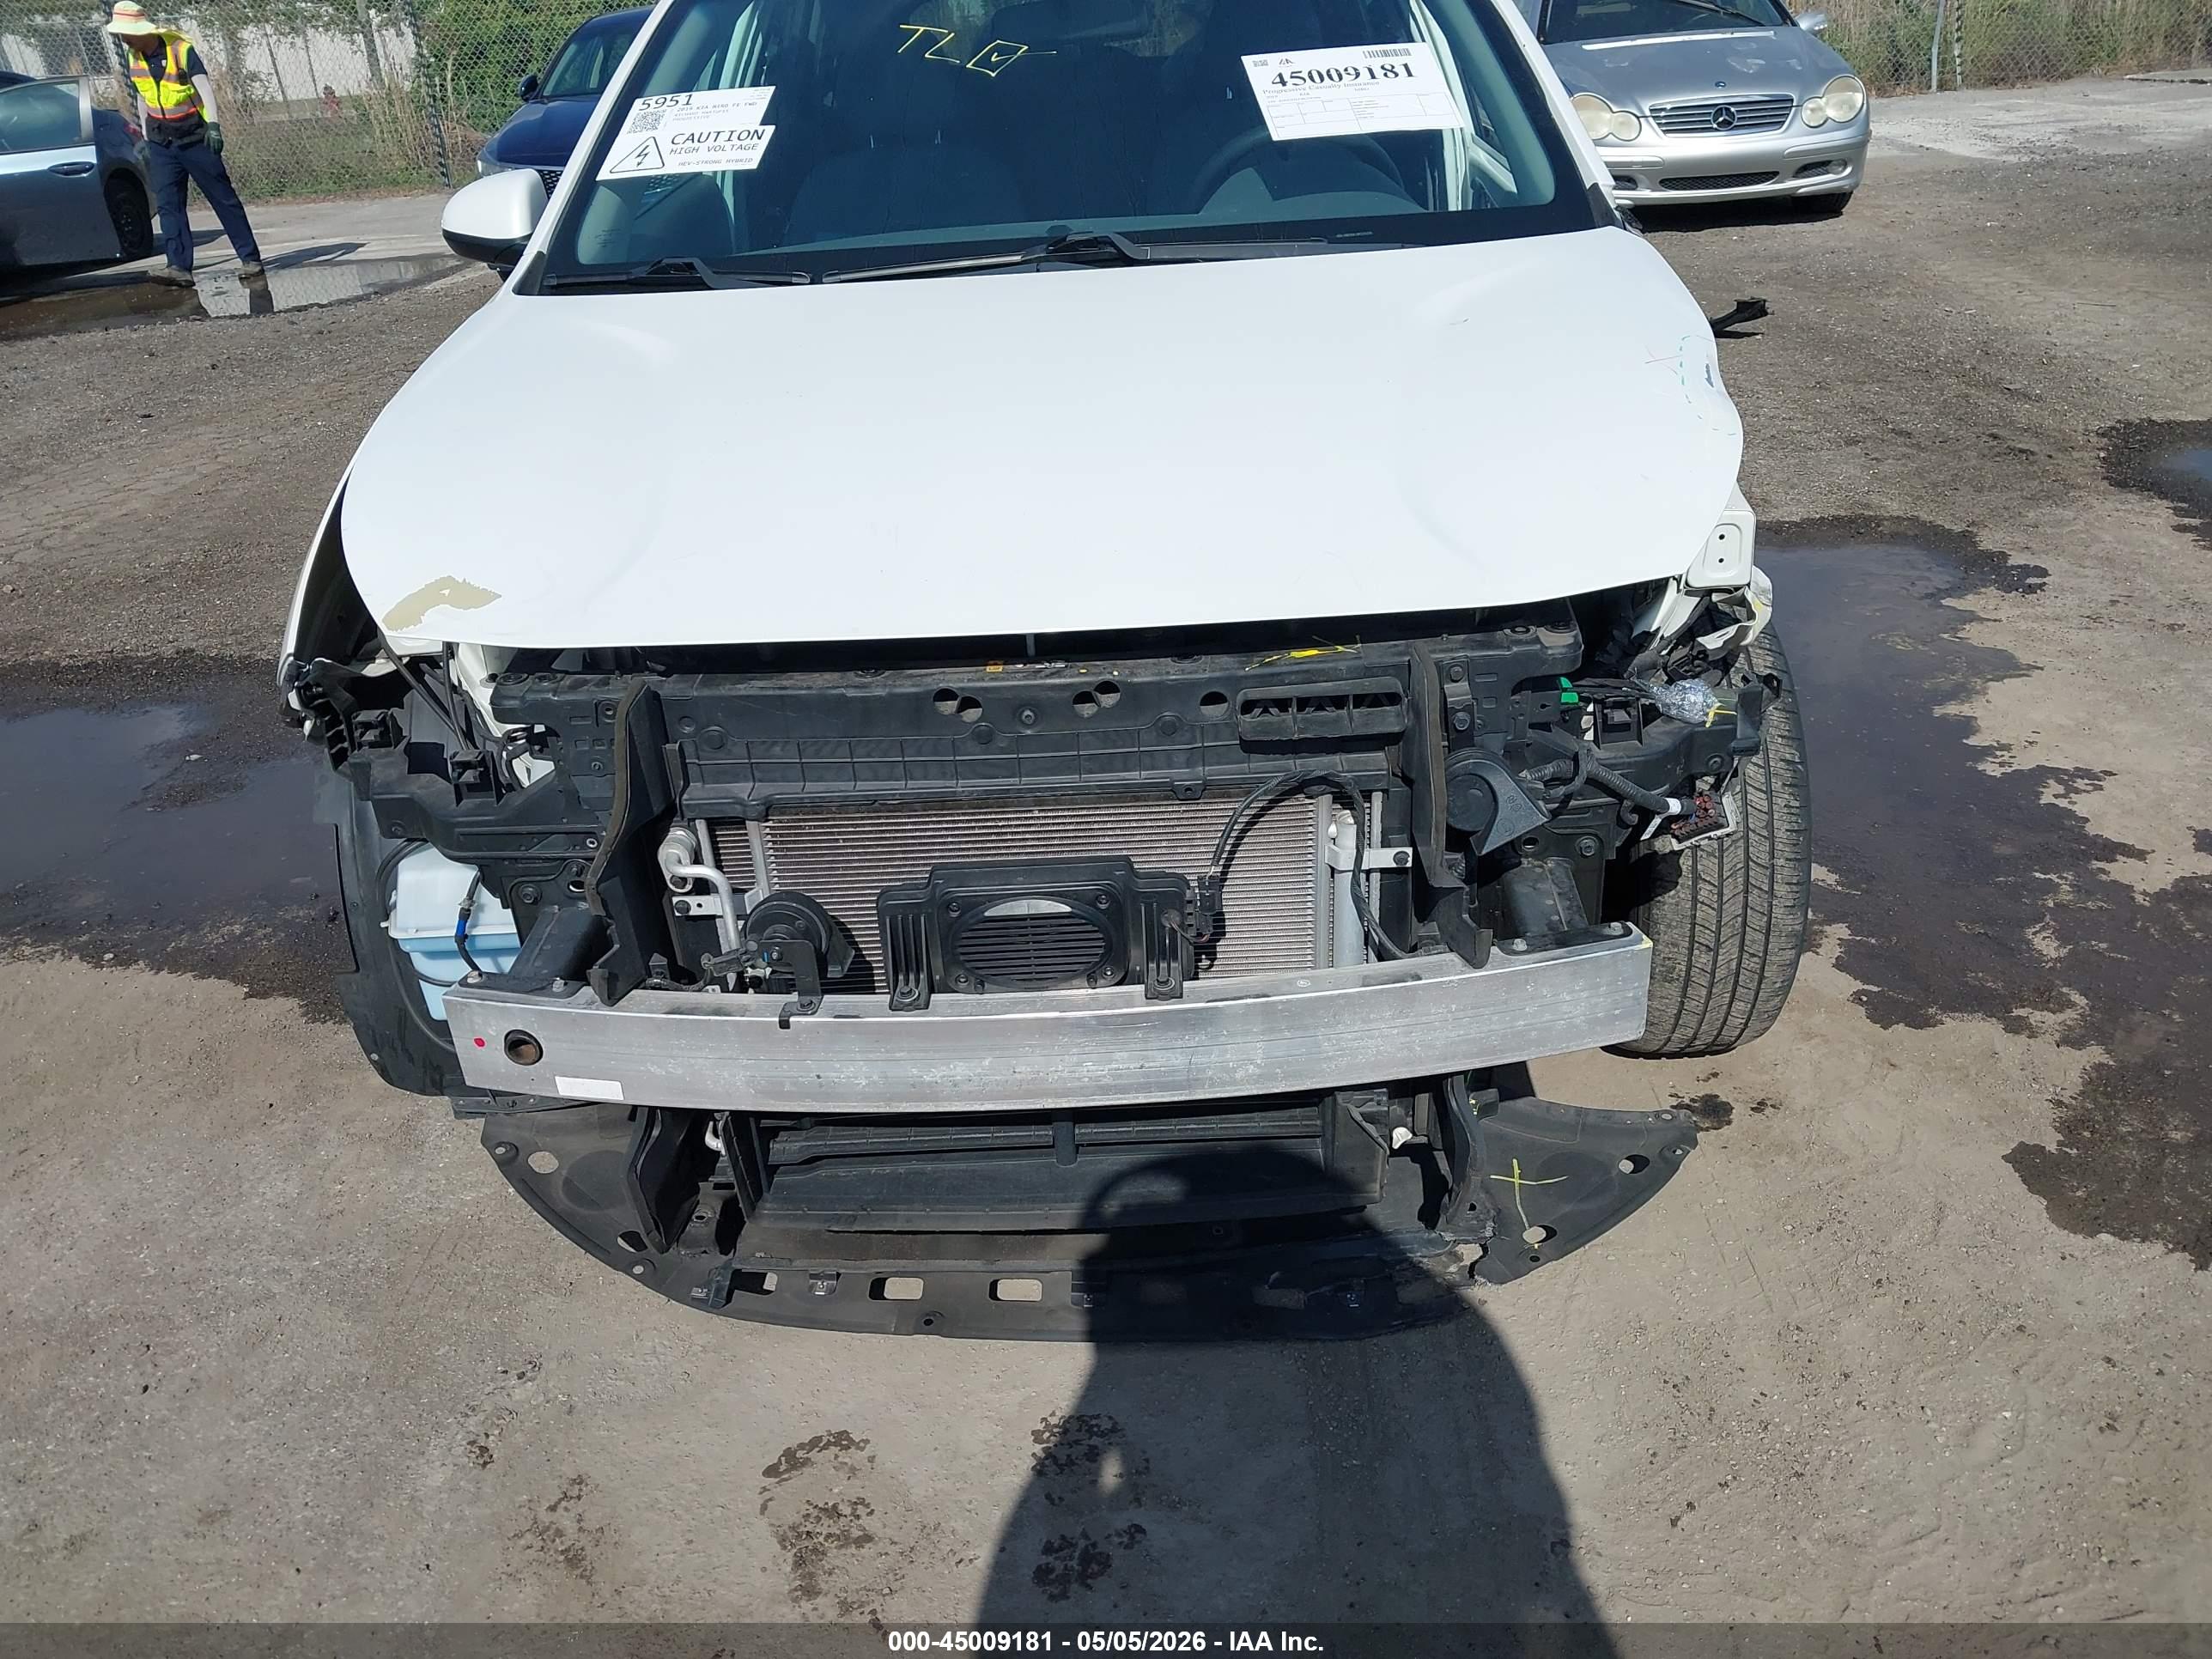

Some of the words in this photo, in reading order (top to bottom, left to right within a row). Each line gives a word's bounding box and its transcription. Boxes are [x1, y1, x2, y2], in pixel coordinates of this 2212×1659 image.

[1271, 62, 1416, 88] 45009181
[638, 94, 694, 112] 5951
[671, 129, 766, 145] CAUTION
[669, 145, 701, 155] HIGH
[707, 143, 759, 153] VOLTAGE
[678, 158, 723, 167] HEV-STRONG
